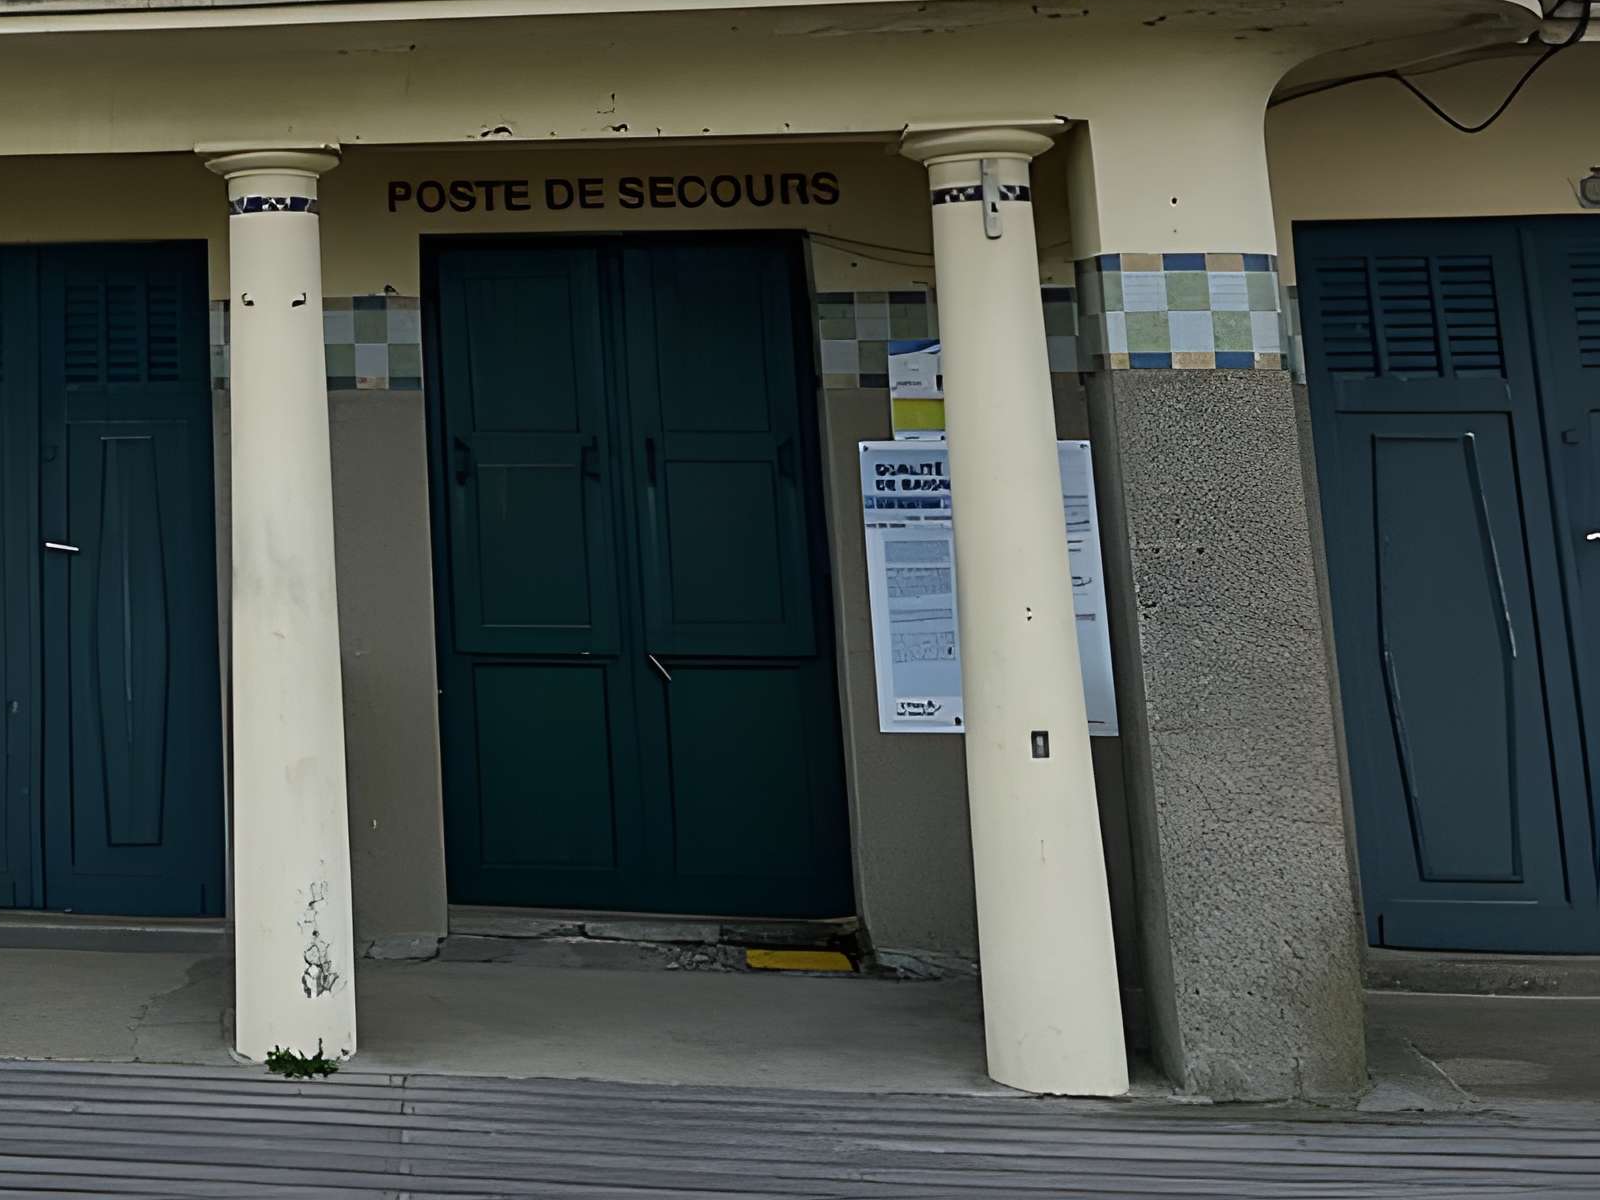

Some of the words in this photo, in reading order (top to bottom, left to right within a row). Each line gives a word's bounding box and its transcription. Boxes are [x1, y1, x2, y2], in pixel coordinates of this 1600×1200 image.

[387, 179, 531, 214] POSTE
[545, 177, 605, 211] DE
[618, 171, 841, 210] SECOURS
